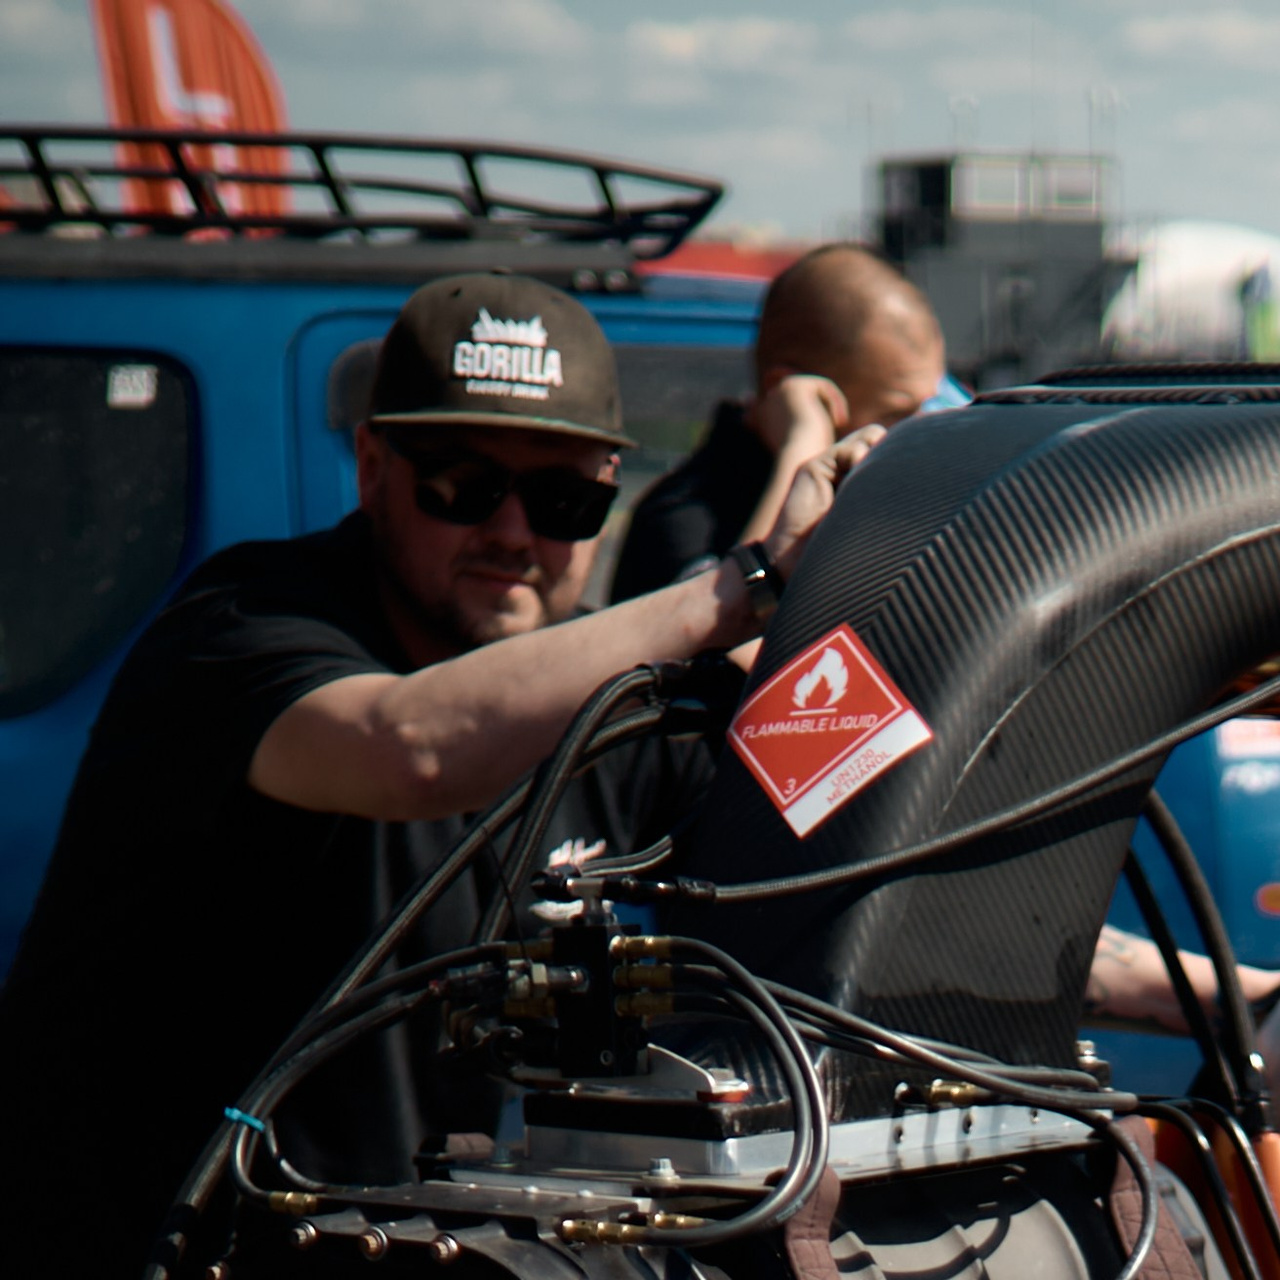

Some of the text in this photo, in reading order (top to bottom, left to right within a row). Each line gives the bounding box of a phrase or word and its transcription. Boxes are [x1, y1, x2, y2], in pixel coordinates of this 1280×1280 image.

[454, 341, 564, 388] GORILLA
[742, 714, 878, 739] FLAMMABLE LIQUID
[783, 778, 797, 795] 3
[826, 751, 891, 805] METHANOL
